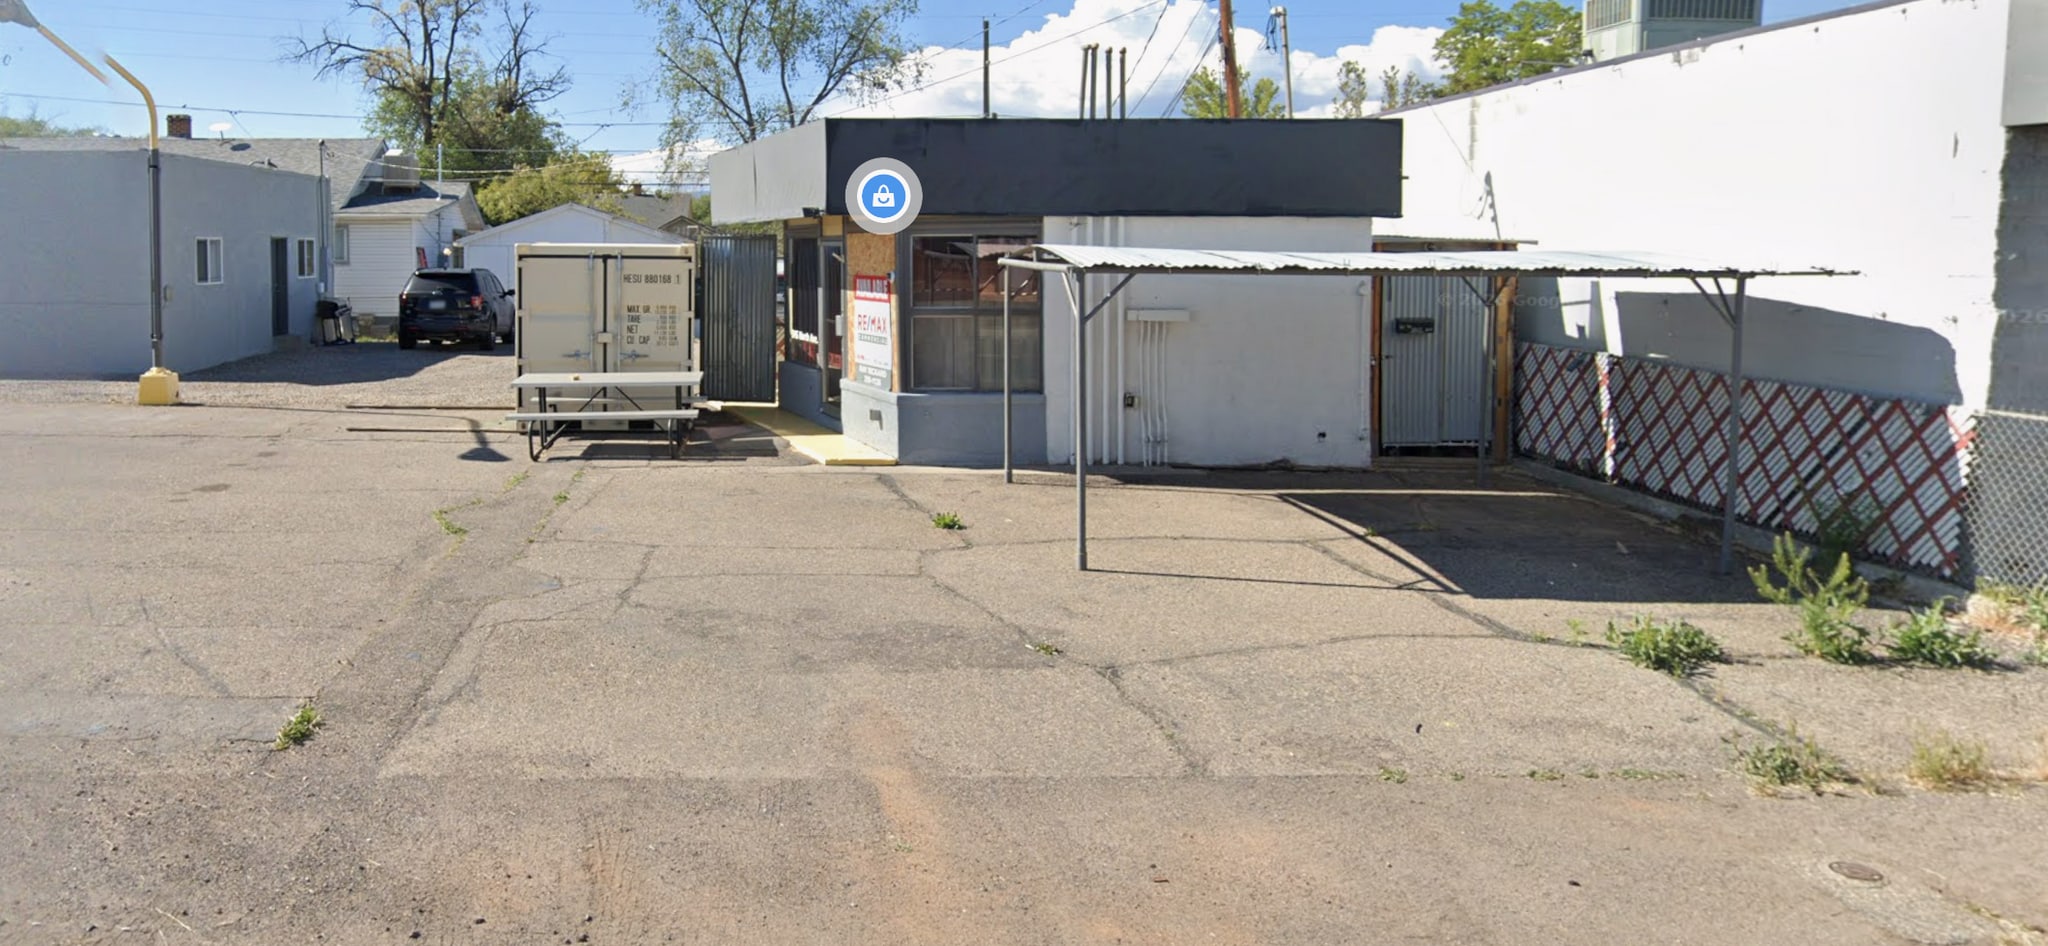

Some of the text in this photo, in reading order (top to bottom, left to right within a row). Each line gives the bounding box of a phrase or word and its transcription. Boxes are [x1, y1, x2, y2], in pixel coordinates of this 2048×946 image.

[856, 278, 889, 299] AVAILABLE
[627, 324, 638, 334] NET
[857, 314, 887, 334] RE/MAX
